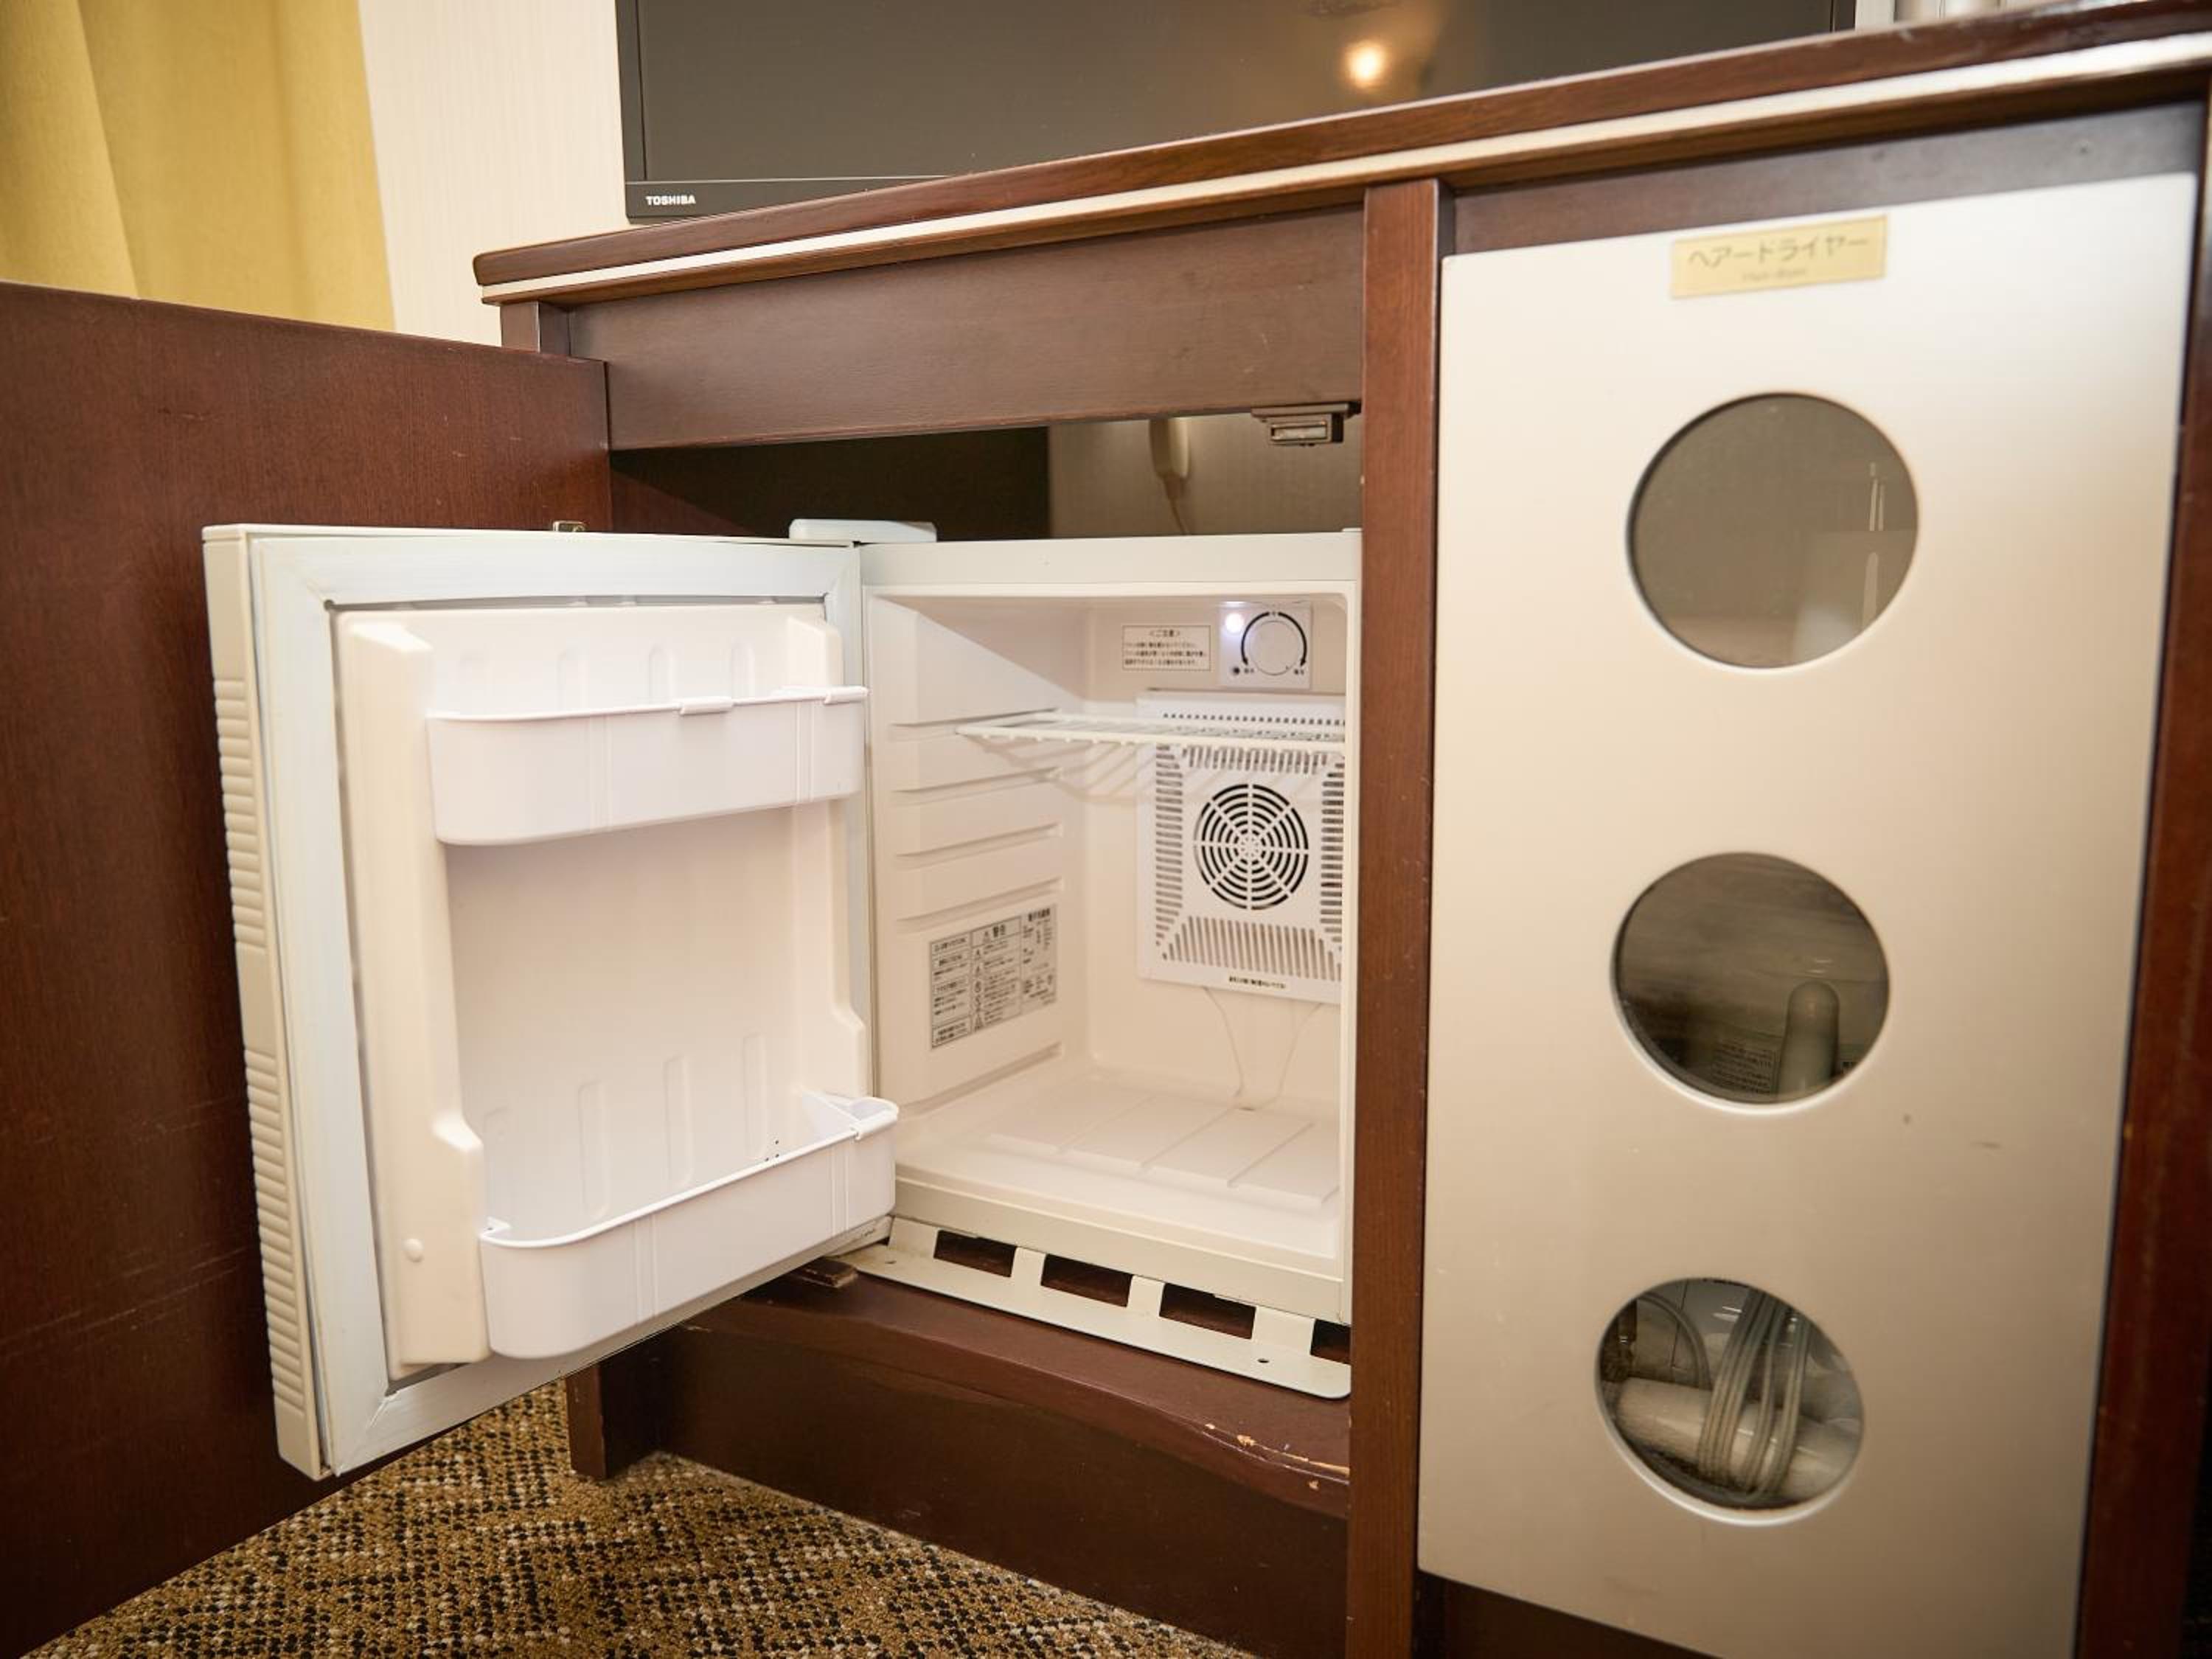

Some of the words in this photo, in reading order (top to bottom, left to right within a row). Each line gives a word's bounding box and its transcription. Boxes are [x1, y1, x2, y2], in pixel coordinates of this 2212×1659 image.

[645, 195, 697, 206] TOSHIBA
[1688, 234, 1869, 269] ヘアードライヤー
